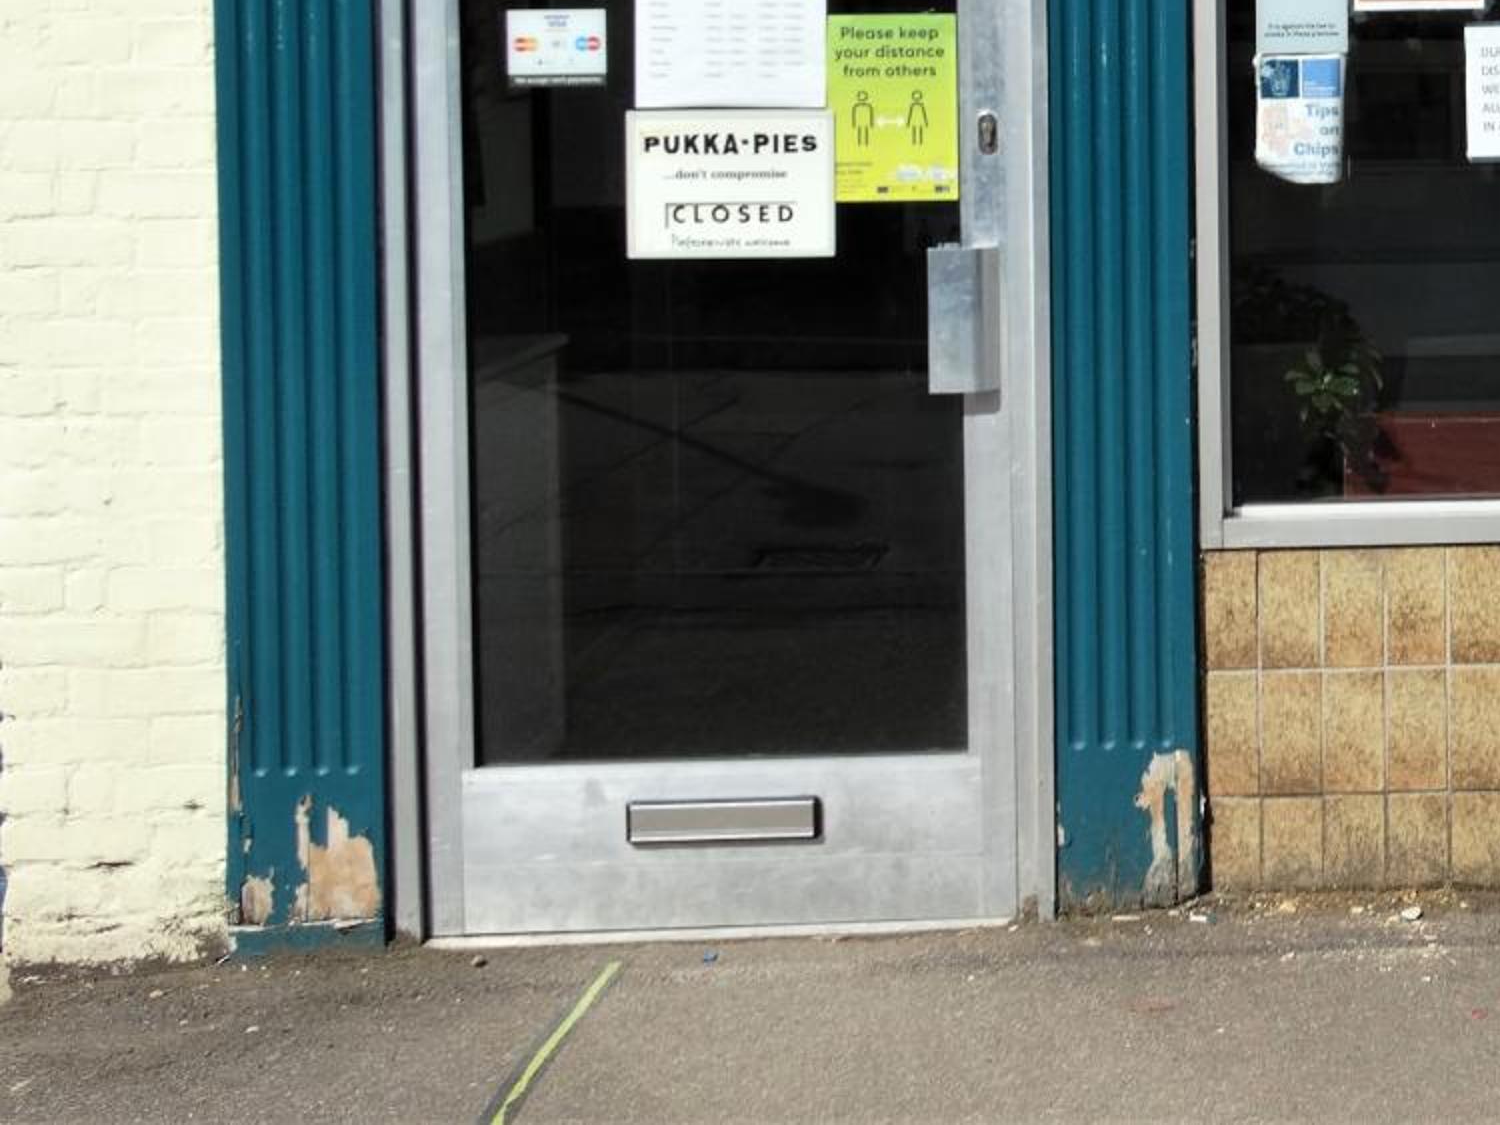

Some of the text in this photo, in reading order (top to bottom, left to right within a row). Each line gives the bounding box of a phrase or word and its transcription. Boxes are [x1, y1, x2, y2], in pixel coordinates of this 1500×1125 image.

[840, 26, 940, 42] Please keep
[835, 45, 945, 62] your distance
[843, 64, 937, 77] from others
[1482, 82, 1500, 95] WE
[1305, 103, 1339, 119] Tips
[1483, 121, 1495, 132] IN
[1294, 142, 1340, 158] Chips
[710, 168, 788, 182] compromise
[672, 204, 794, 224] CLOSED
